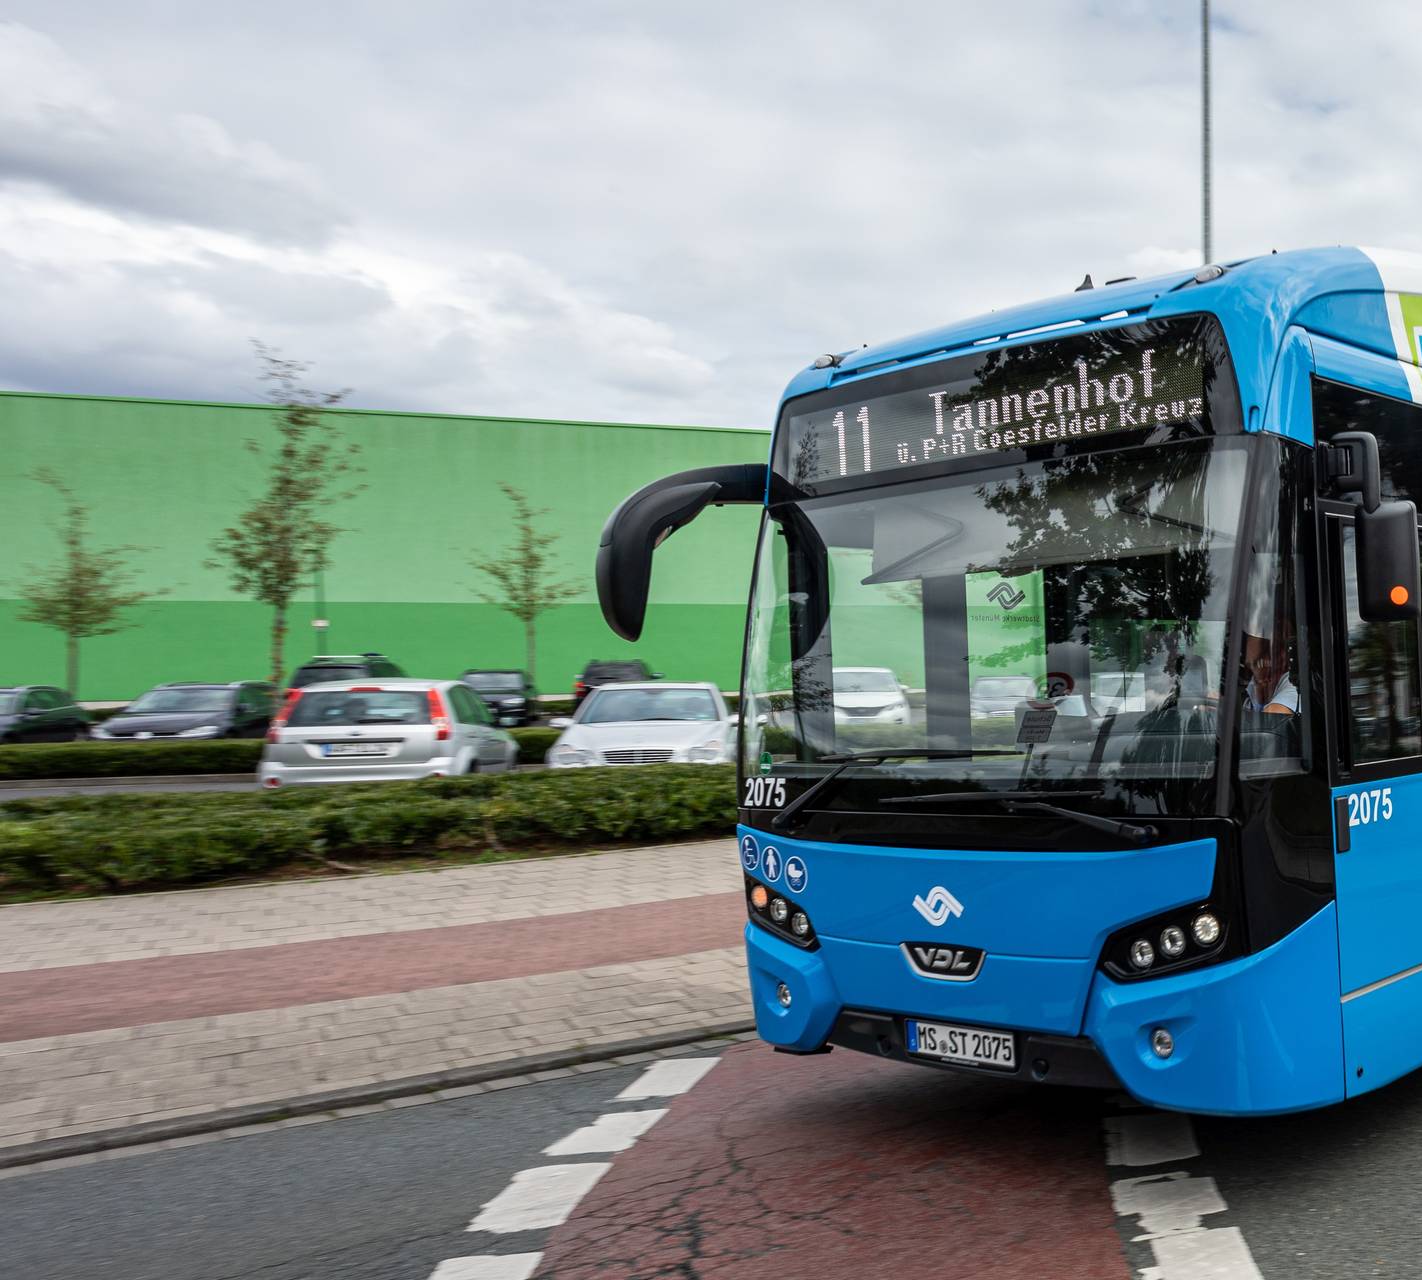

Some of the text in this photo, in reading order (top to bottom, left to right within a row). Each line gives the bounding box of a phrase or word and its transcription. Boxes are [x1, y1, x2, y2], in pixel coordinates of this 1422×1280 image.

[928, 348, 1157, 435] Tannenhof
[832, 406, 871, 476] 11
[923, 433, 966, 455] P+R
[973, 412, 1109, 452] Coesfelder
[1119, 398, 1202, 427] Kreuz
[744, 777, 786, 807] 2075
[1348, 787, 1393, 827] 2075
[914, 946, 972, 970] VDL
[918, 1025, 1012, 1062] MS ST 2075
